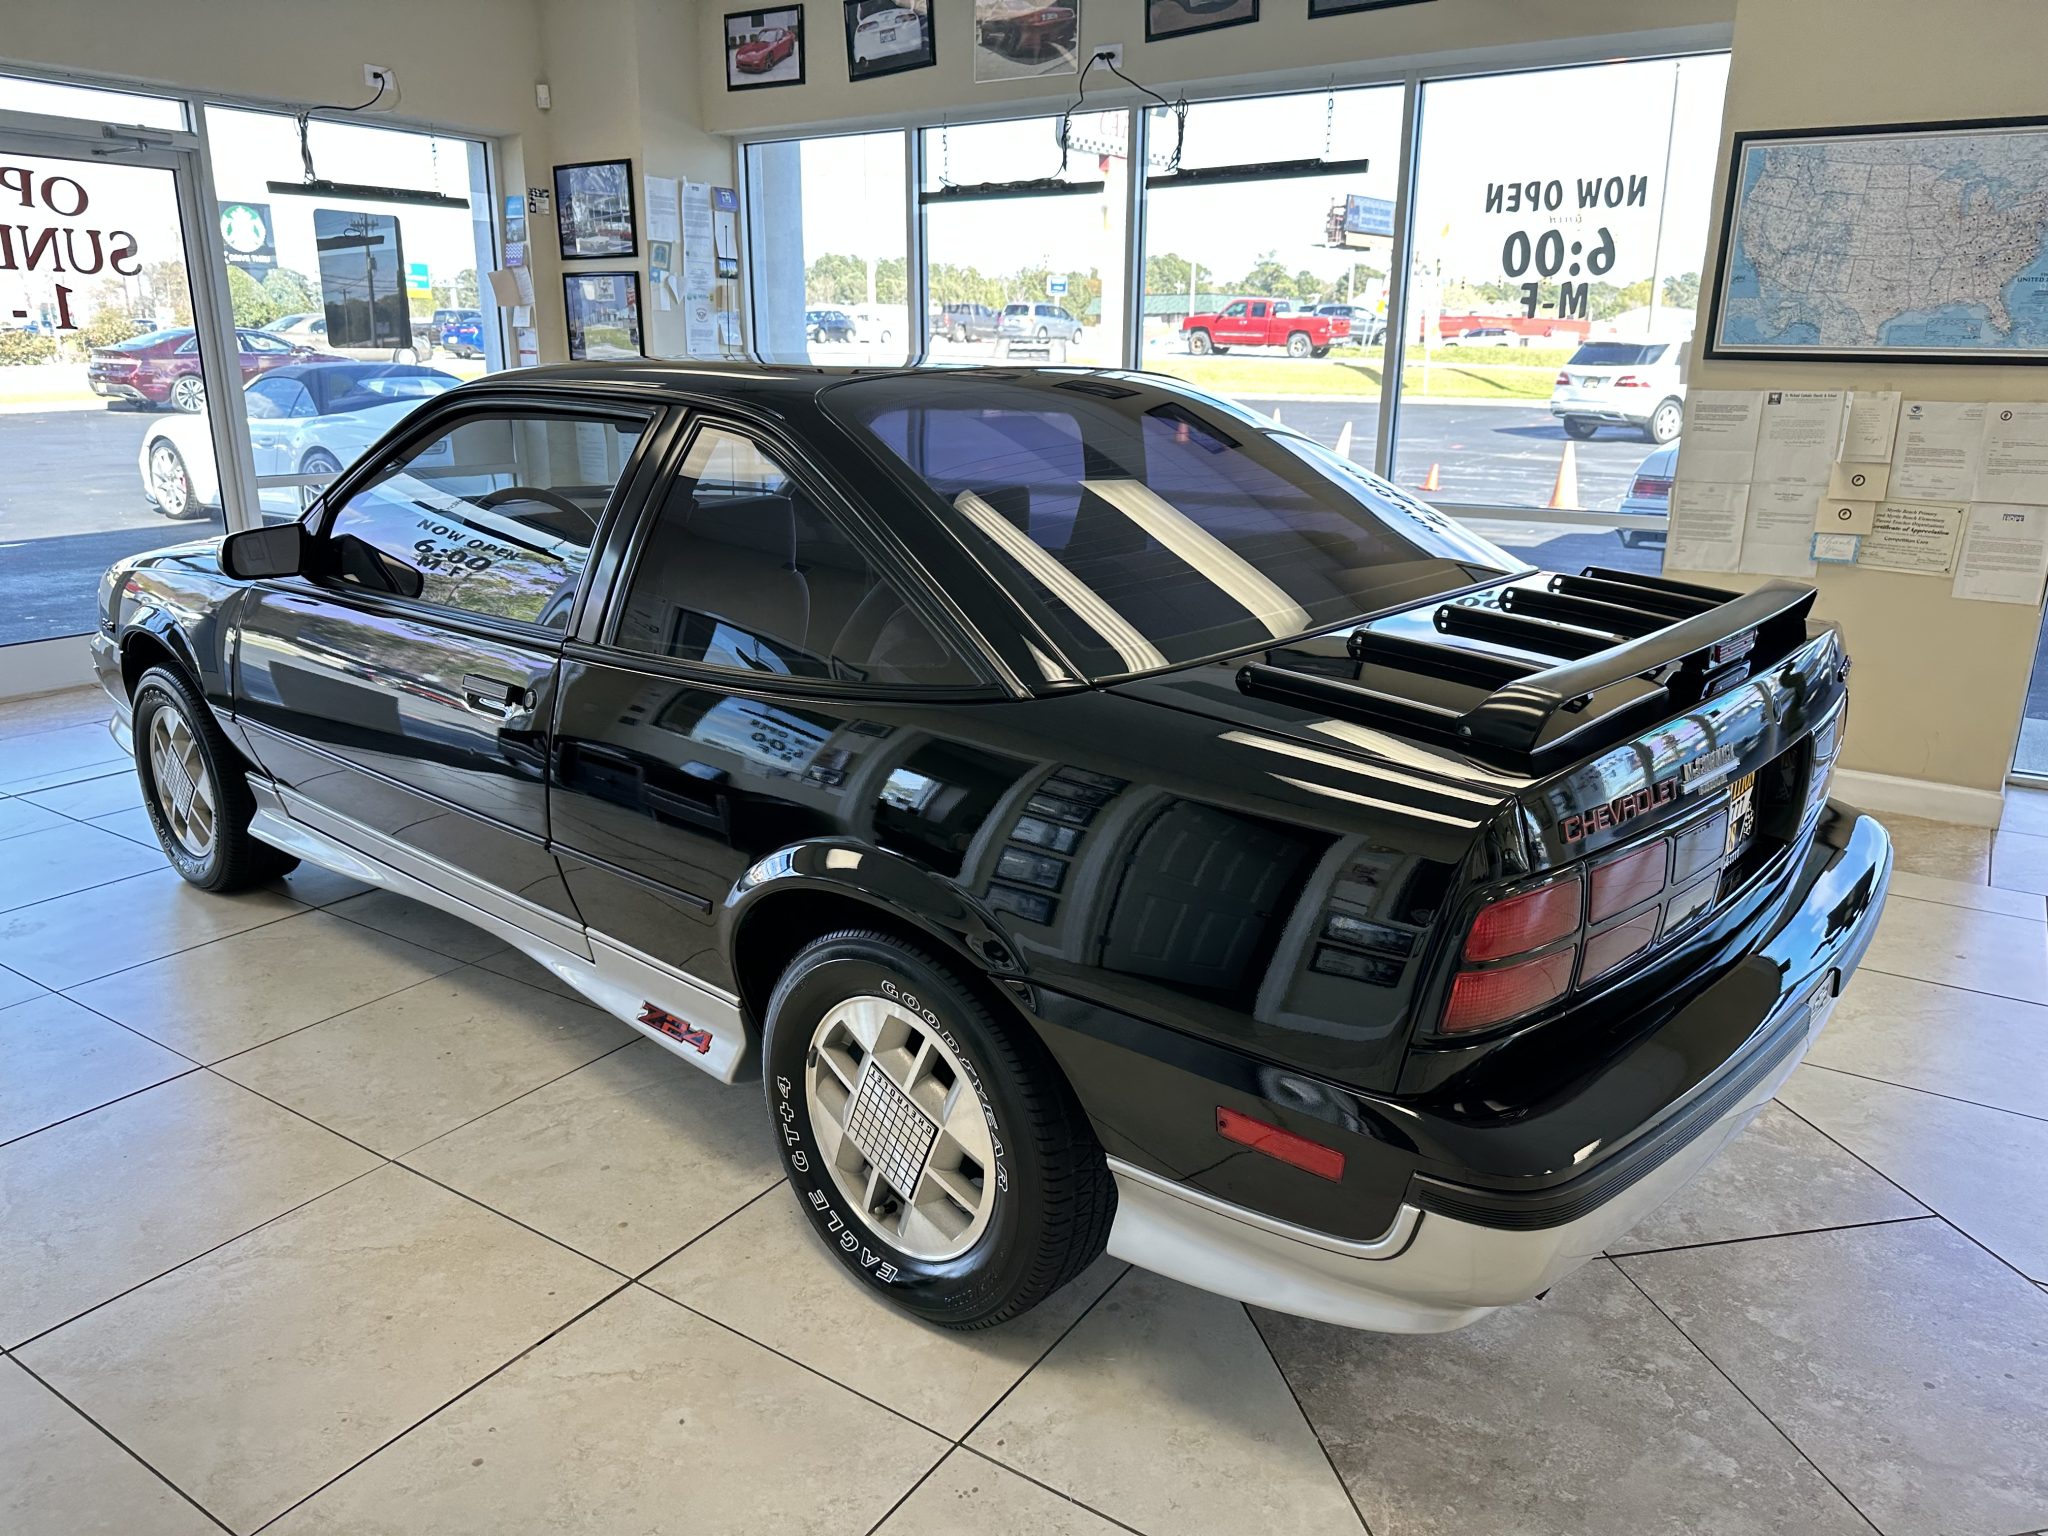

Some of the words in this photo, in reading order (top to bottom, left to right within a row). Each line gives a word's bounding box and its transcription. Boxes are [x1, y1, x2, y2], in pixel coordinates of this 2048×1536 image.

[414, 539, 492, 571] 6:00
[416, 518, 467, 542] NOW
[466, 538, 520, 561] OPEN
[416, 555, 465, 578] M-F
[1561, 775, 1680, 844] CHEVROLET
[637, 1000, 713, 1055] Z24
[869, 1069, 933, 1135] CHEVROLET
[881, 979, 1009, 1192] GOODYEAR
[776, 1075, 809, 1173] GT+4
[808, 1189, 899, 1284] EAGLE
